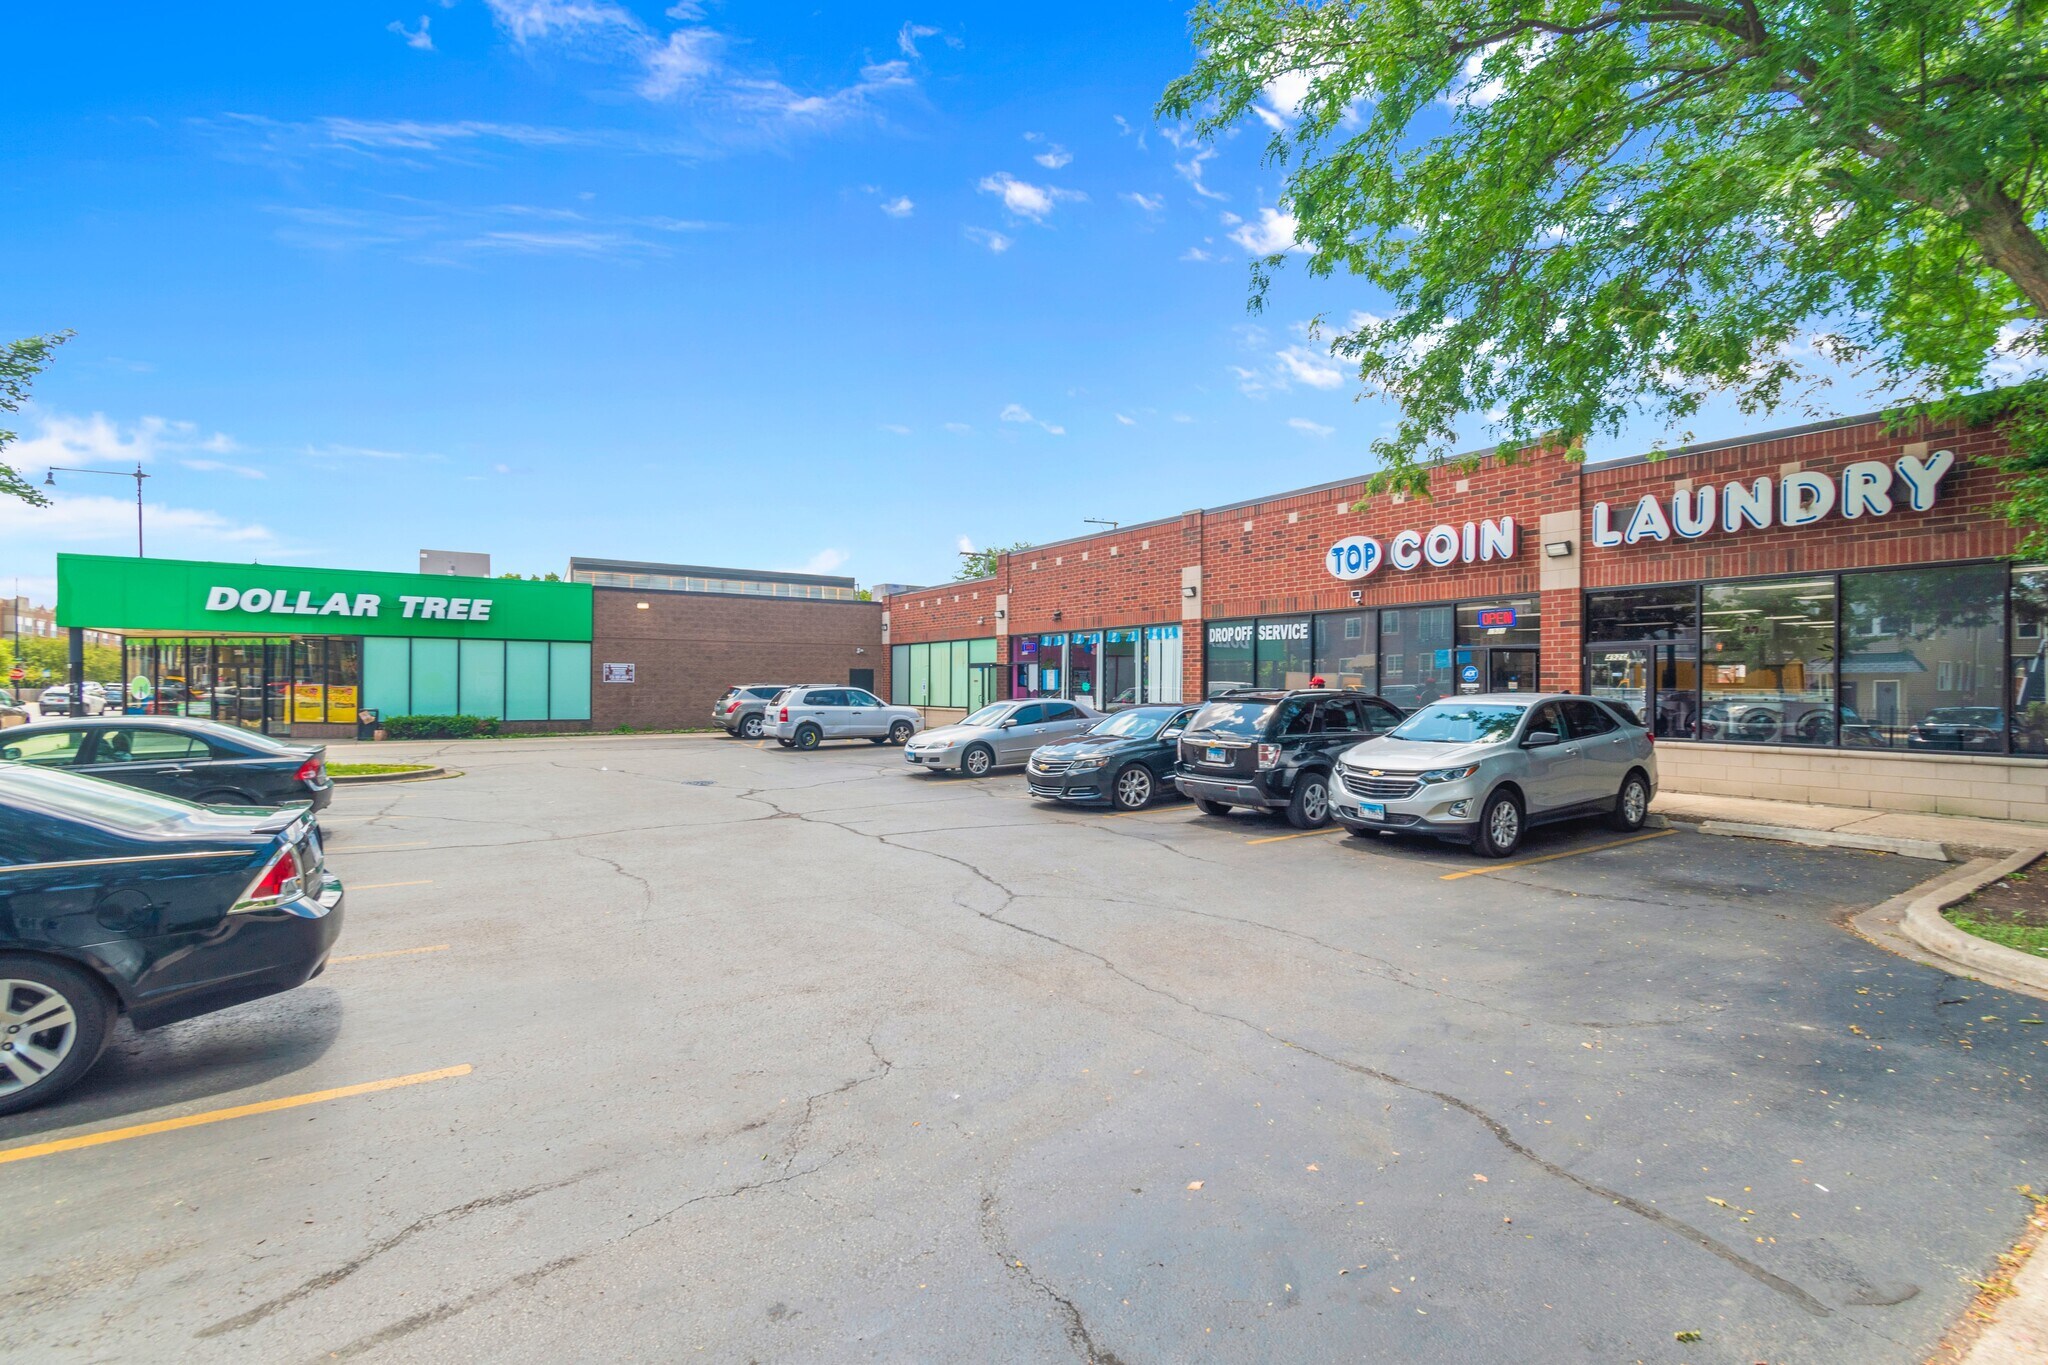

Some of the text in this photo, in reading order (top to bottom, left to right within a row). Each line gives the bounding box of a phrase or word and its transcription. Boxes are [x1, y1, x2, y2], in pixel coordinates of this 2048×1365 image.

[1331, 449, 1955, 575] TOP COIN LAUNDRY
[205, 586, 493, 621] DOLLAR TREE
[1482, 611, 1513, 625] OPEN
[1258, 623, 1308, 641] SERVICE
